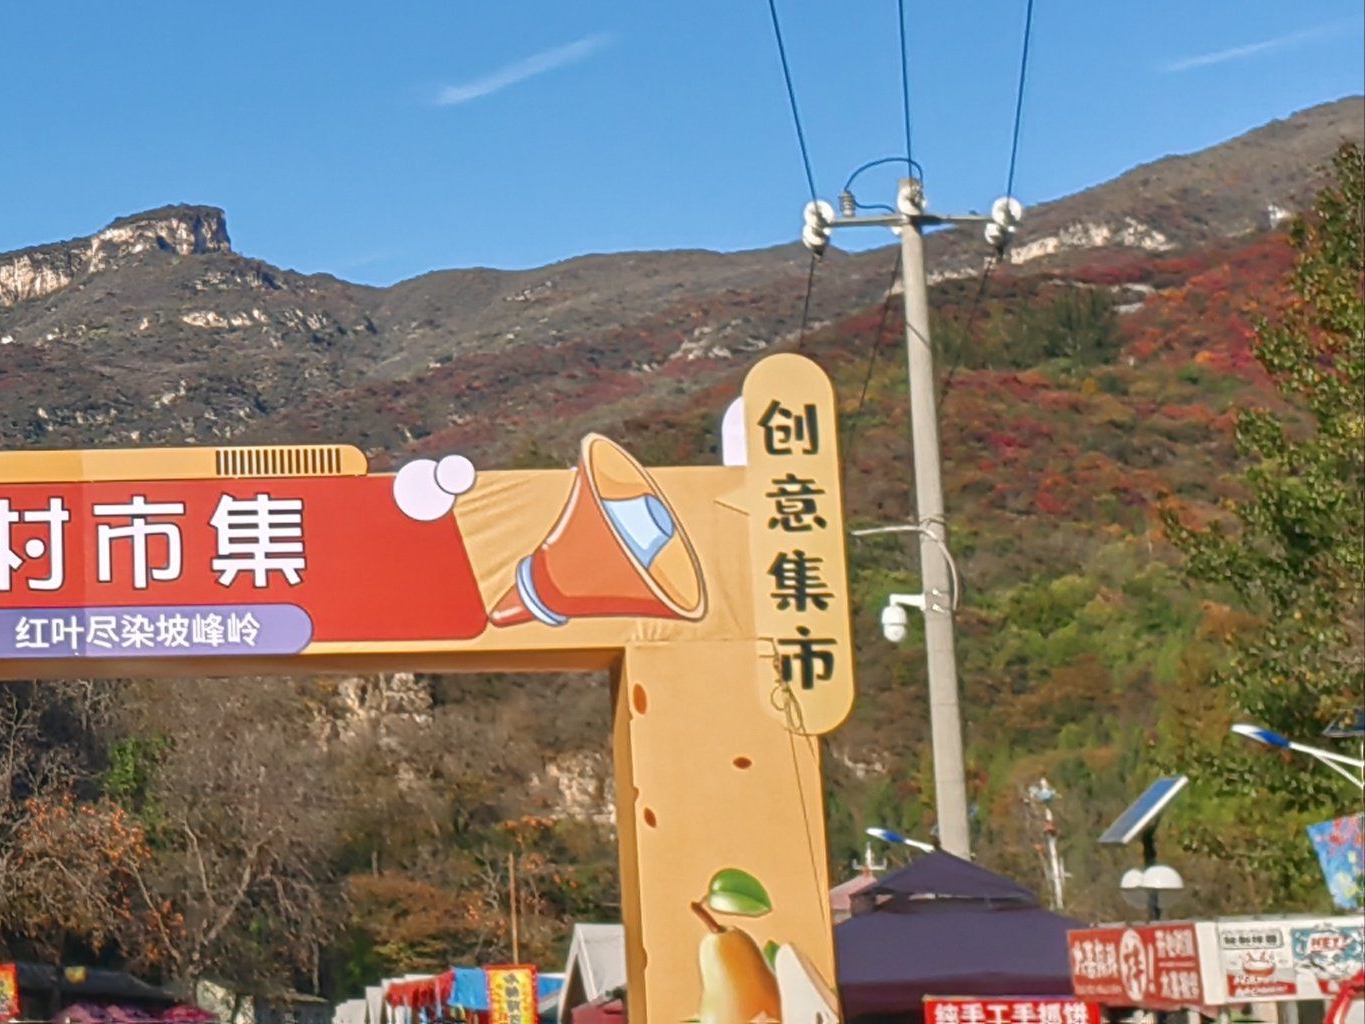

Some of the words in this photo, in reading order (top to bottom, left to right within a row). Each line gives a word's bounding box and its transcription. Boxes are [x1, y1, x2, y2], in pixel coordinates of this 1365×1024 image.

[757, 398, 838, 690] 创意集市
[14, 612, 261, 651] 红叶尽染坡峰岭
